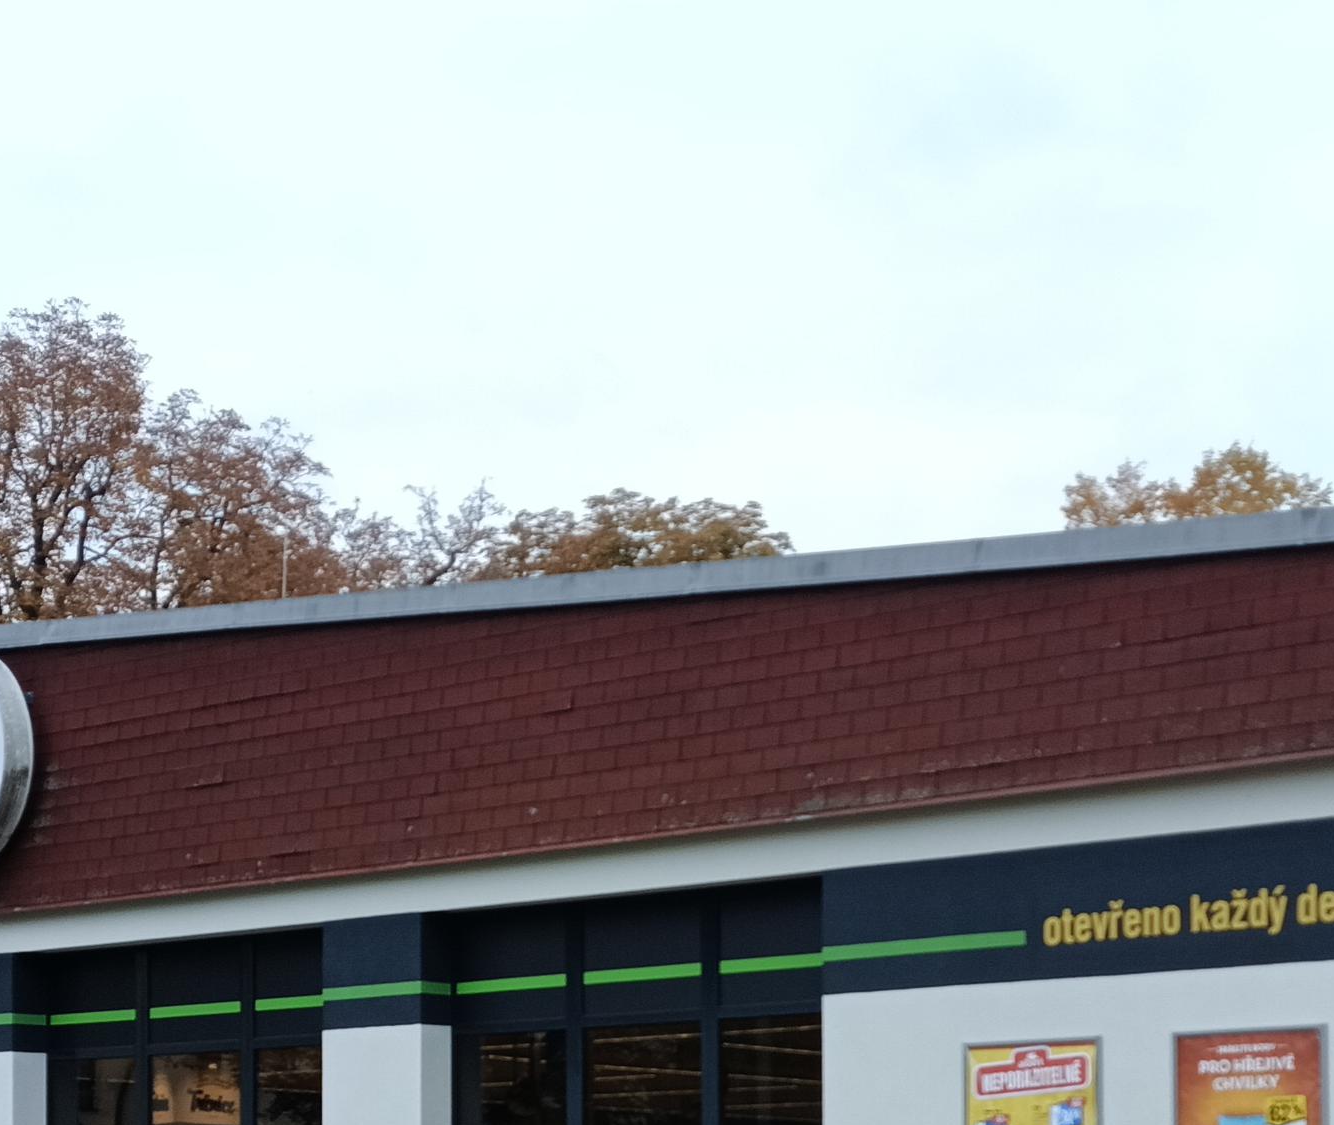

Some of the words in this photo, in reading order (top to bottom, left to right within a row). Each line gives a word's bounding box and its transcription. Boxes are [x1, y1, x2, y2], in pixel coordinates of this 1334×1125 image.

[1042, 899, 1181, 948] otevřeno
[1189, 884, 1288, 936] každý
[1198, 1058, 1231, 1075] PRO
[1212, 1073, 1280, 1091] CHVILKY
